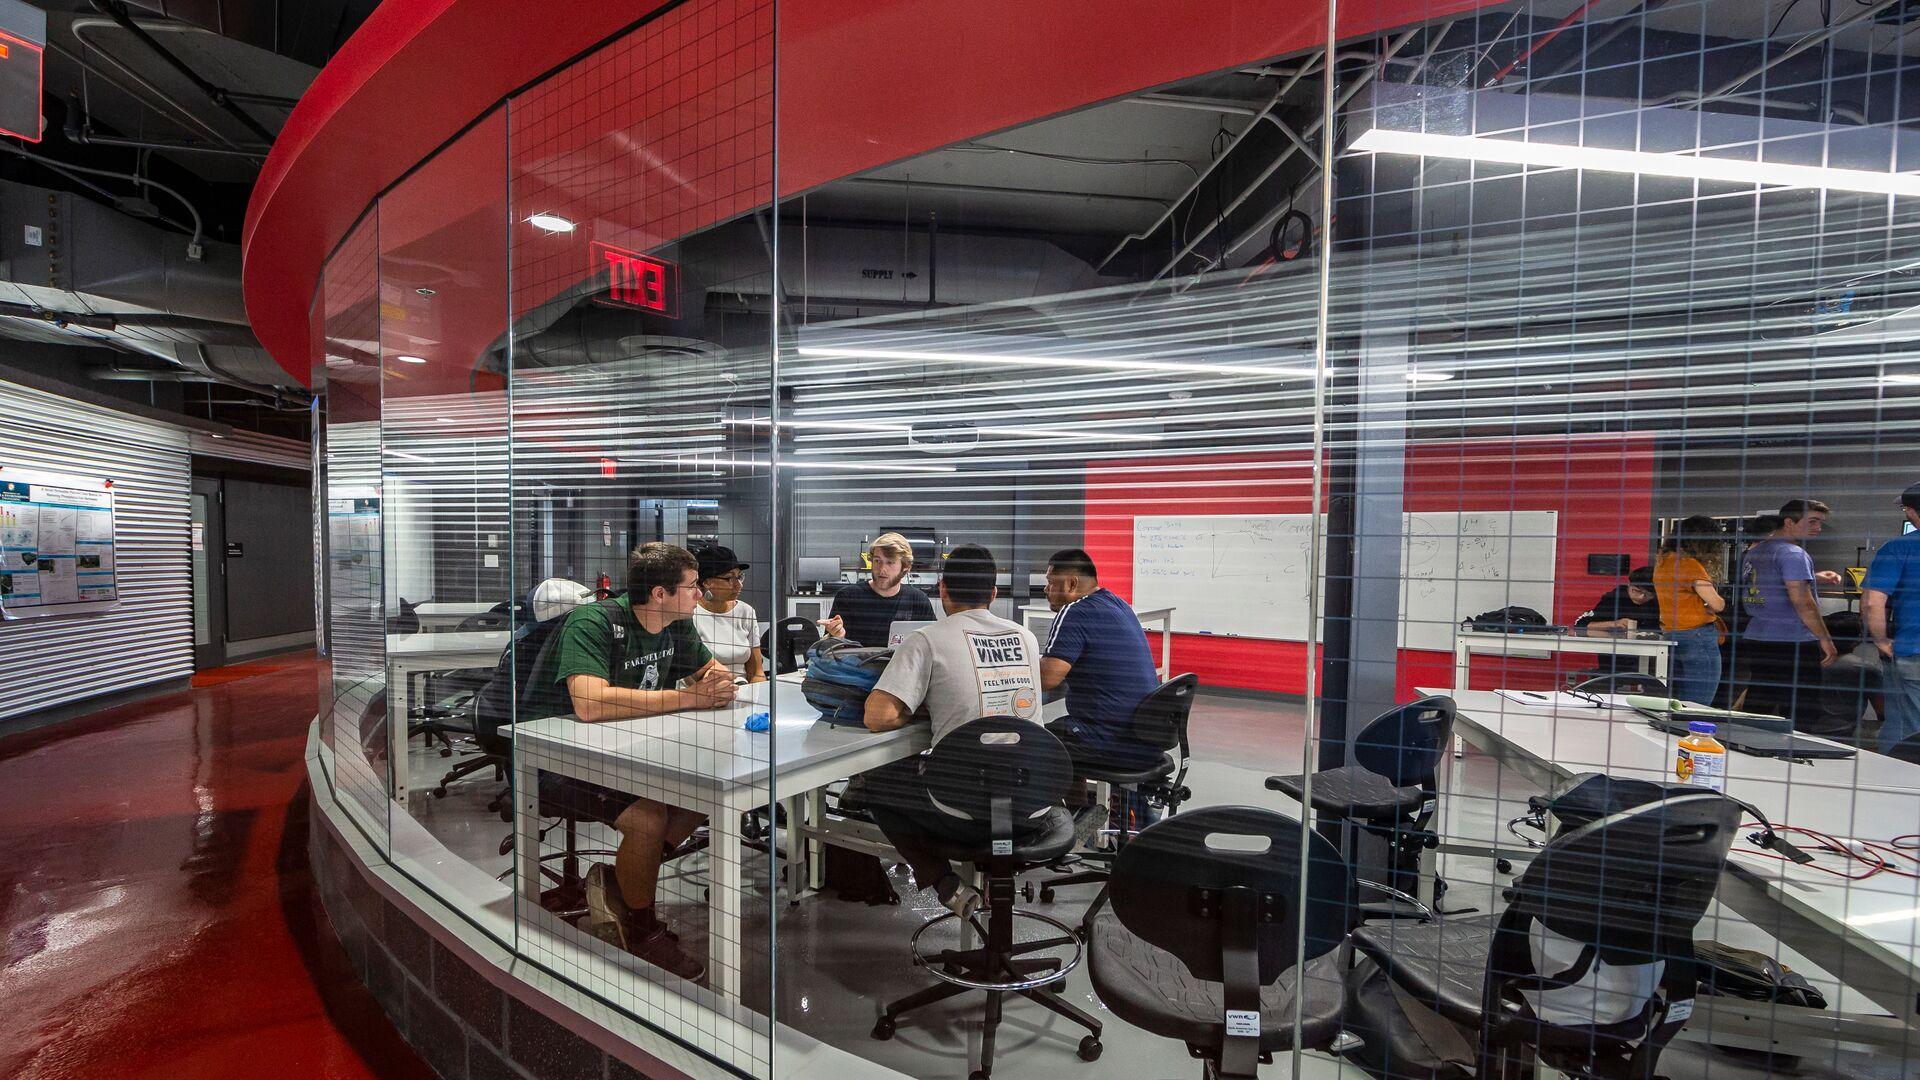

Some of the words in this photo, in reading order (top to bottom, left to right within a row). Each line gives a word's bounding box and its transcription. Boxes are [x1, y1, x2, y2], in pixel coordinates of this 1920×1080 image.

[862, 269, 894, 280] SUPPLY
[973, 637, 1020, 647] VINEYARD
[977, 647, 1022, 662] VINES
[1001, 678, 1016, 686] THIS
